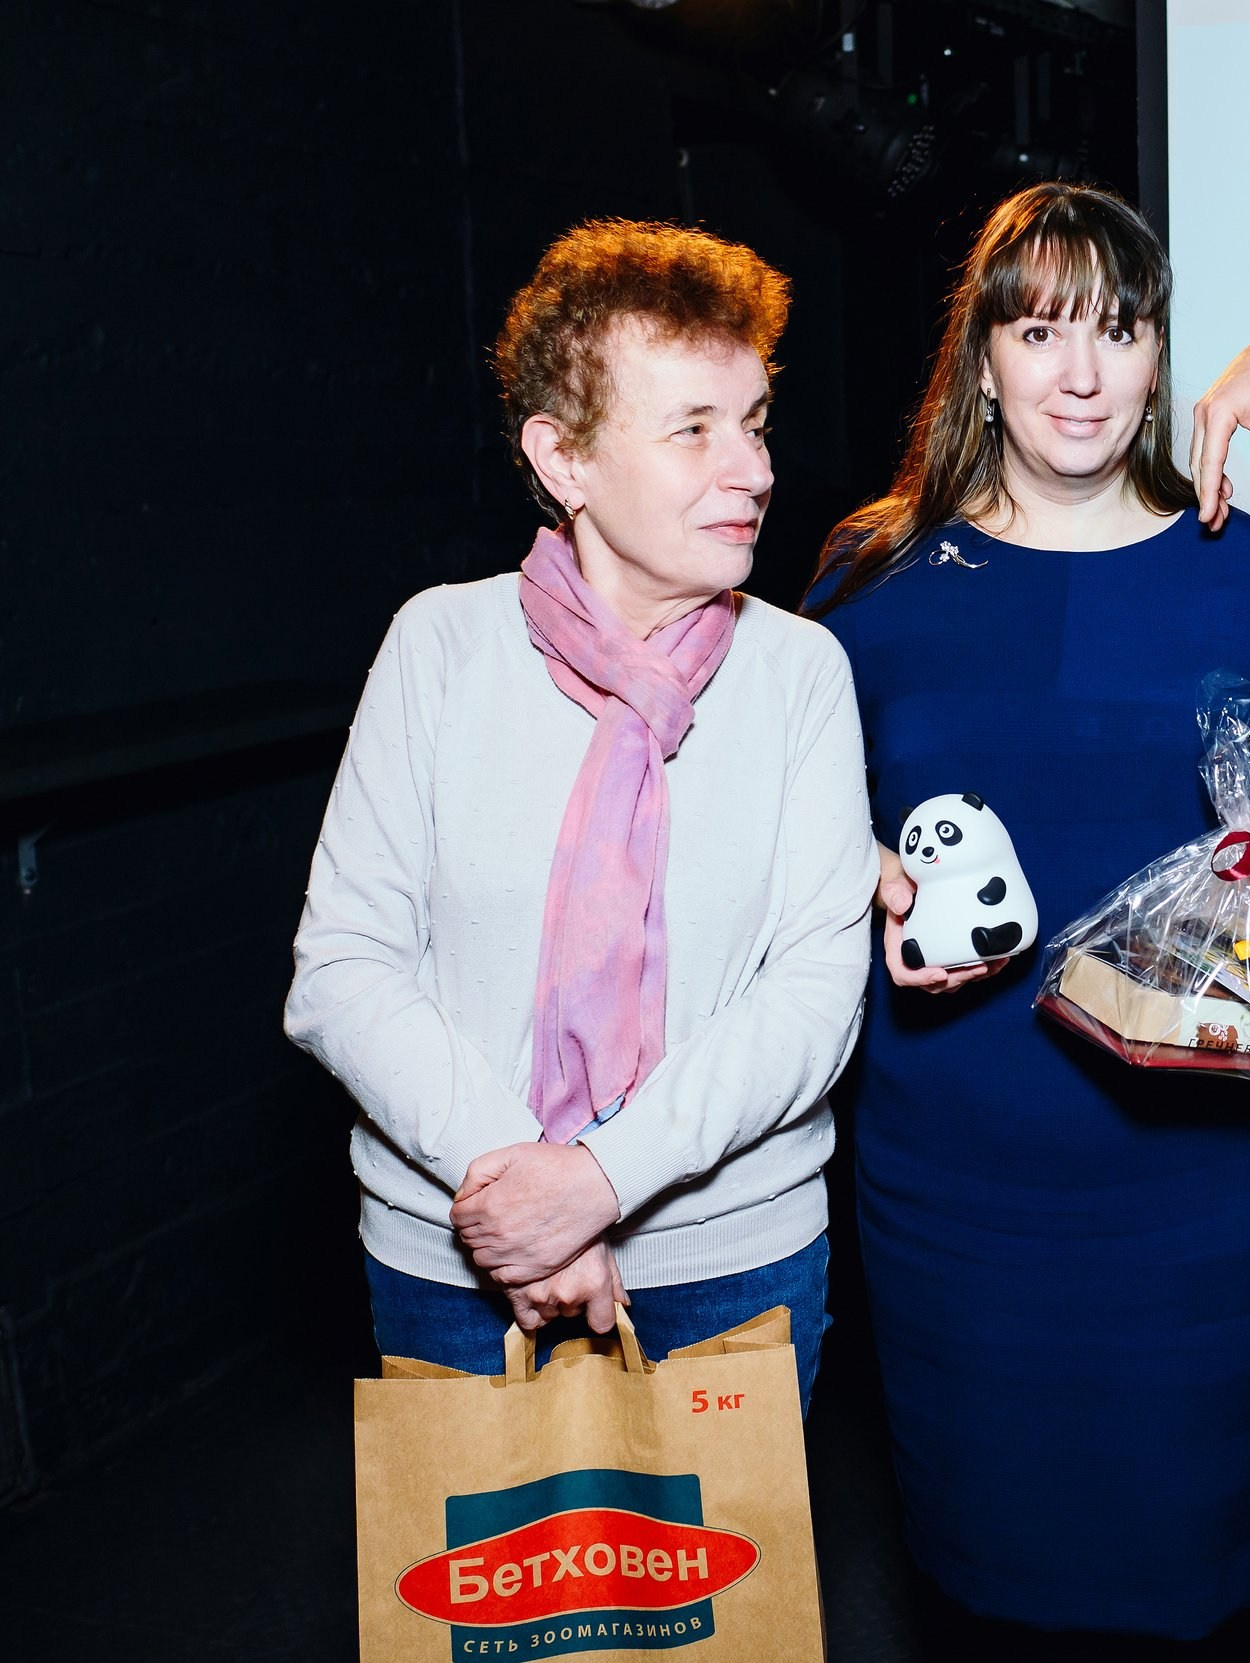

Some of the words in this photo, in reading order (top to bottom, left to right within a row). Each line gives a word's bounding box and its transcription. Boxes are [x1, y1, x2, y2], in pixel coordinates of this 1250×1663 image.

[692, 1389, 709, 1413] 5
[717, 1393, 745, 1411] кг
[447, 1542, 710, 1605] Бетховен
[463, 1639, 519, 1654] СЕТЬ
[530, 1616, 702, 1648] ЗООМАГАЗИНОВ
